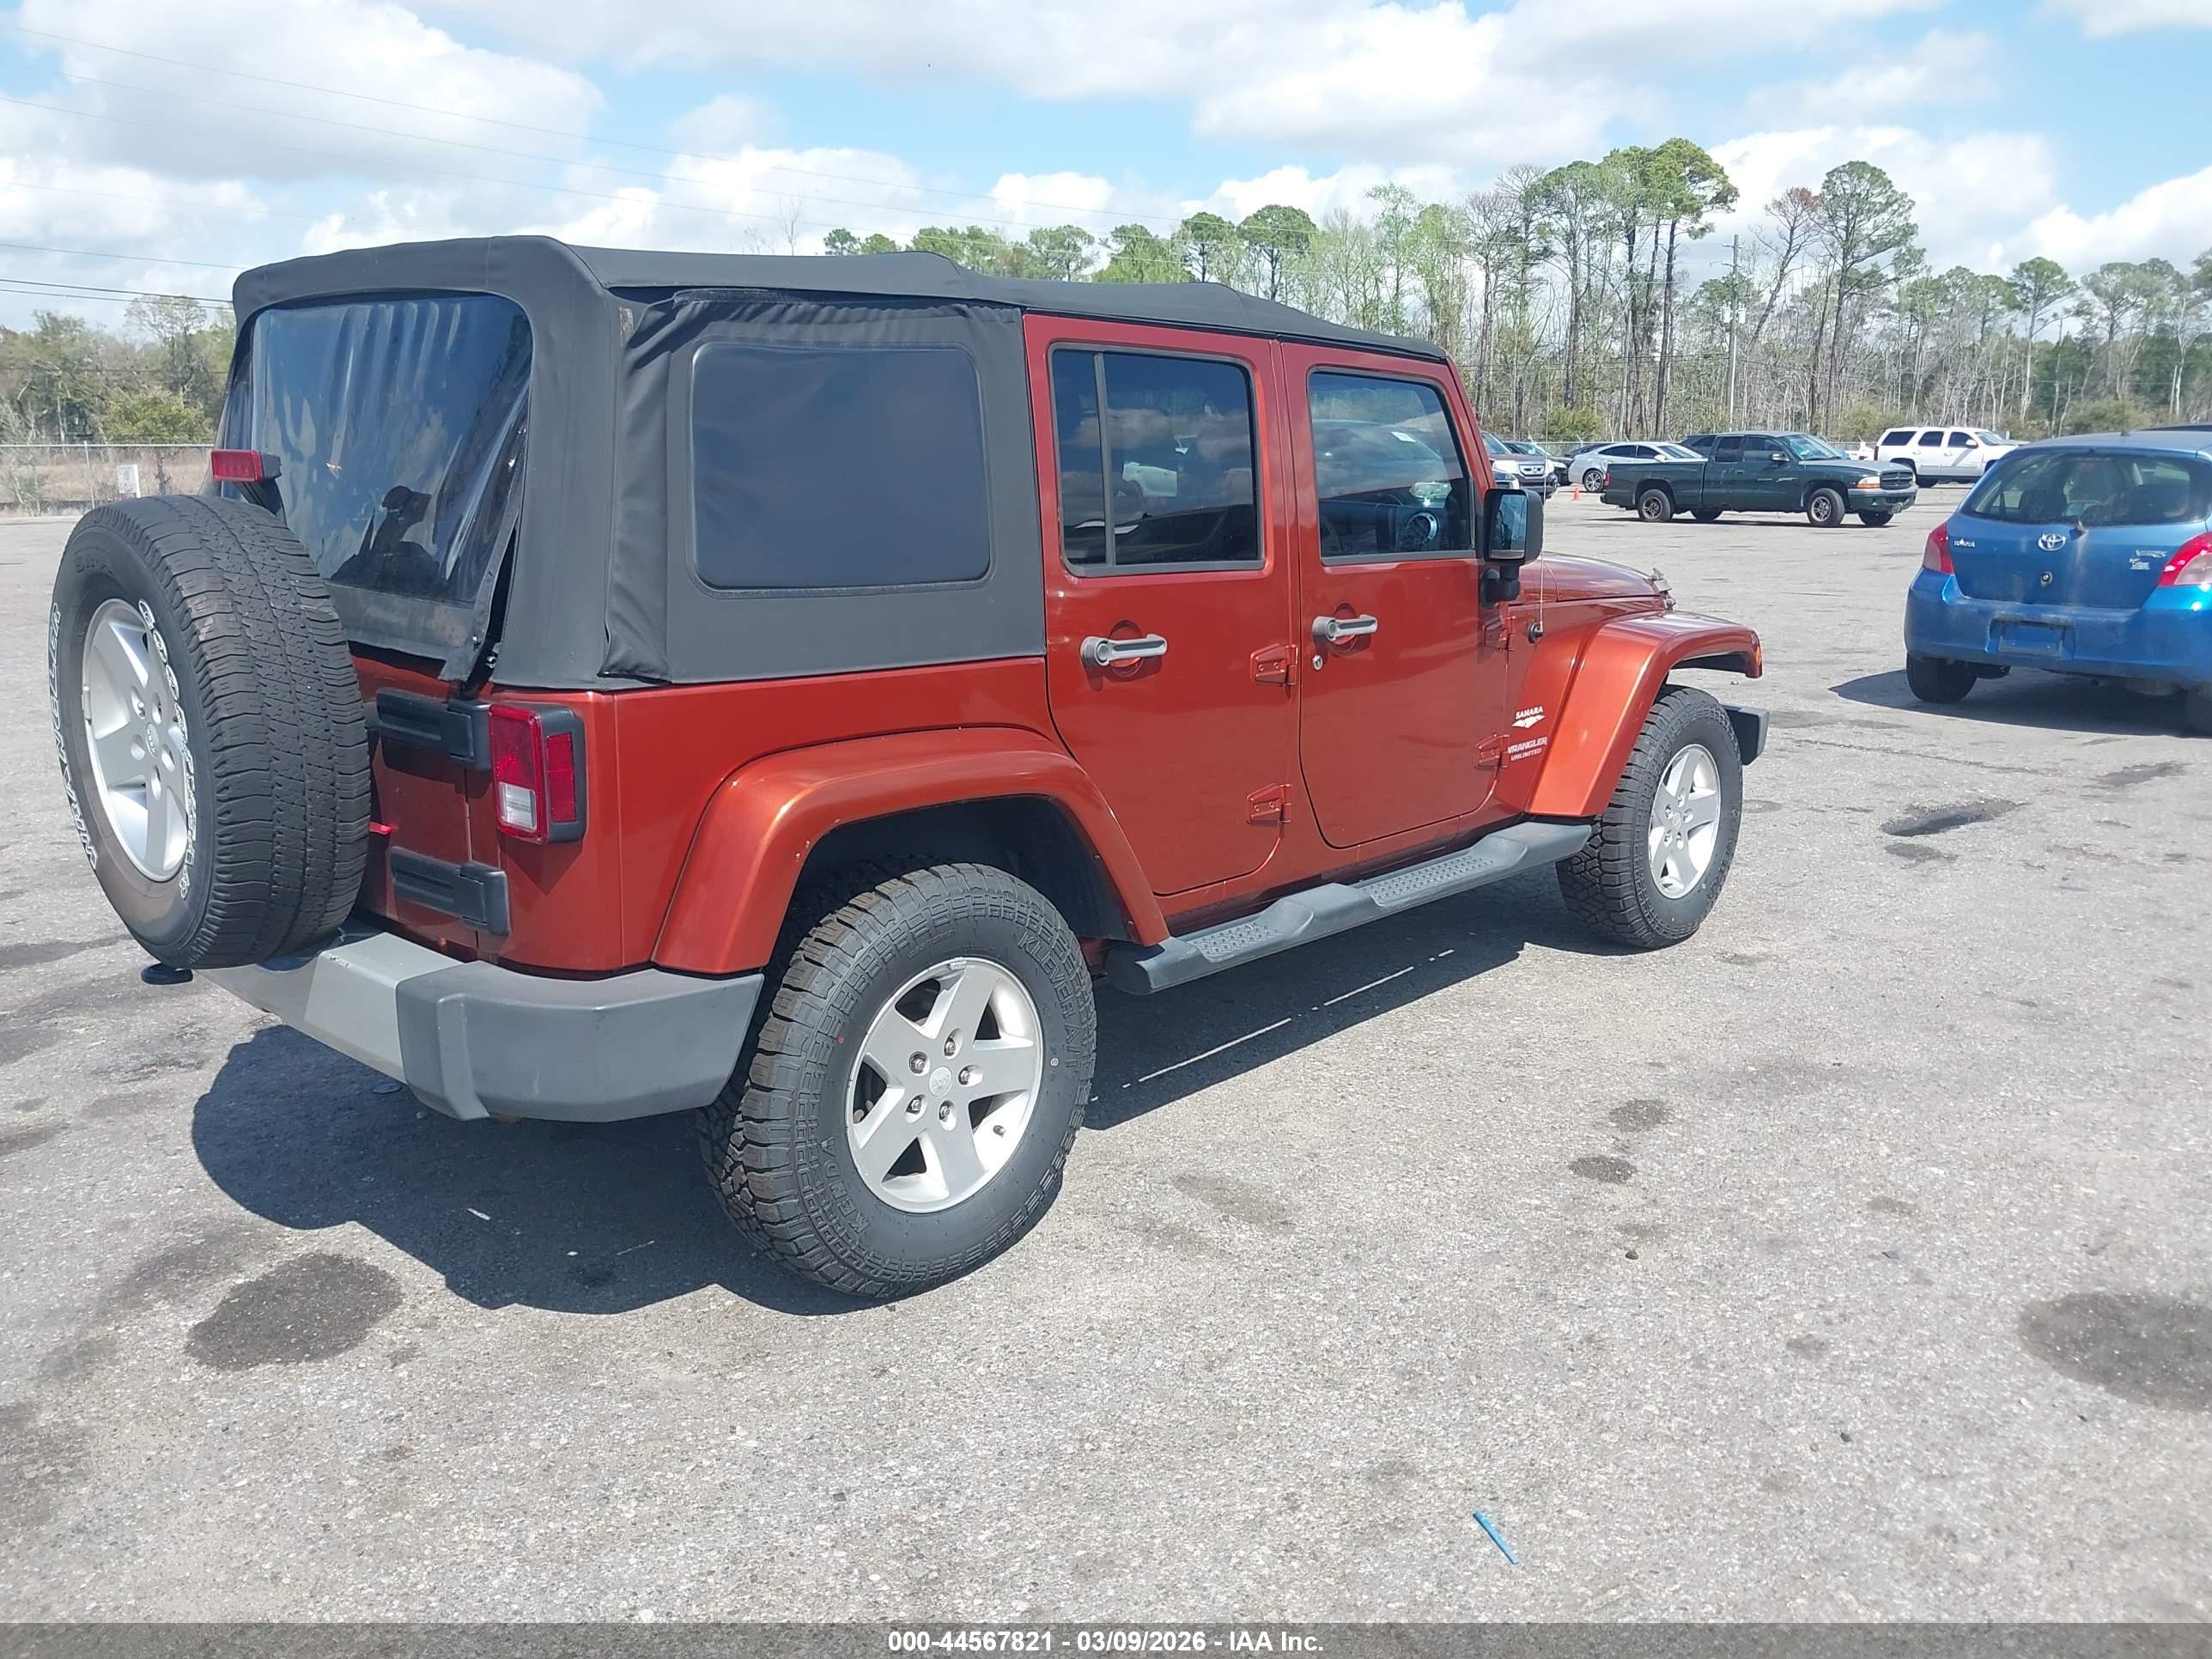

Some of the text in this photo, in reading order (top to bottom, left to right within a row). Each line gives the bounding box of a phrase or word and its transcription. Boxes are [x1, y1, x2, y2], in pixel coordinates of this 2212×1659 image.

[48, 602, 98, 871] WRANGLER
[1515, 705, 1544, 720] SAHARA
[1507, 737, 1548, 754] WRANGLER
[1510, 748, 1542, 762] UNLIMITED
[1018, 932, 1075, 1019] KLEVER
[821, 1134, 872, 1234] KENDA
